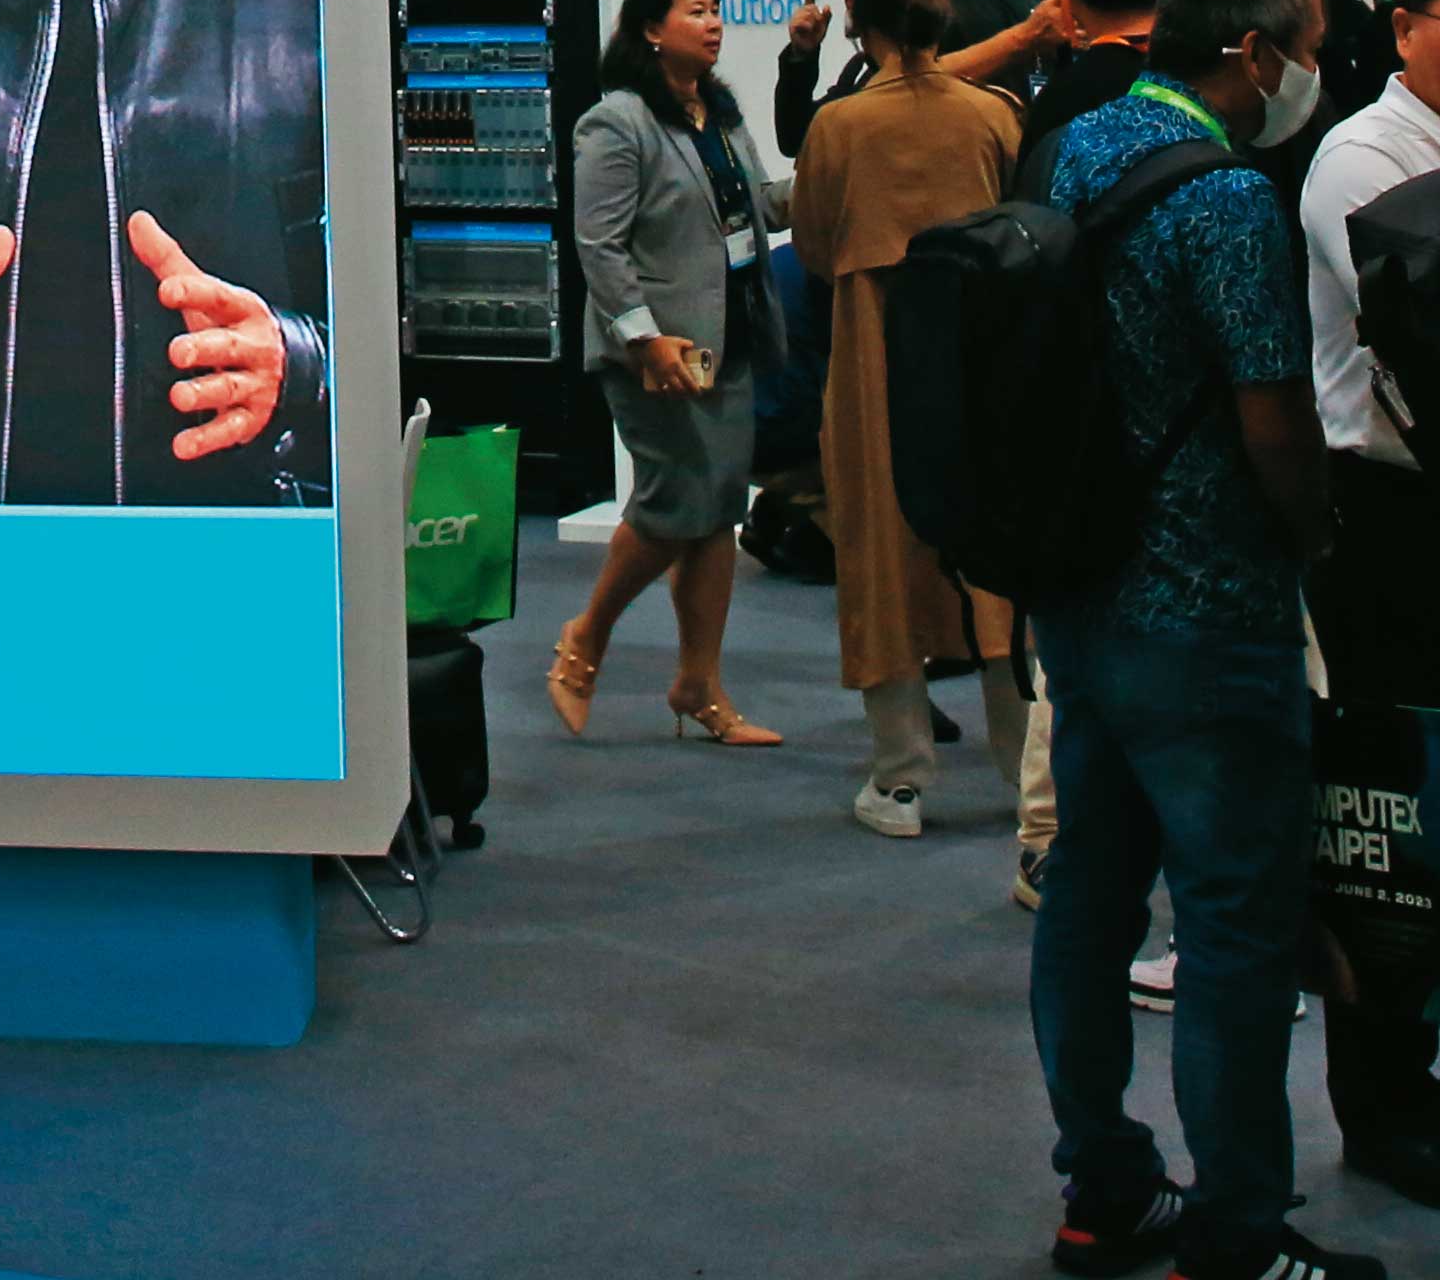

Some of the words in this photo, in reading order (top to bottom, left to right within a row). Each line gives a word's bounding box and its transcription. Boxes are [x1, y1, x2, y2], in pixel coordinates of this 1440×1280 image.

[1312, 783, 1424, 837] MPUTEX
[1312, 825, 1390, 874] AIPEI
[1334, 882, 1374, 899] JUNE
[1394, 891, 1433, 911] 2023
